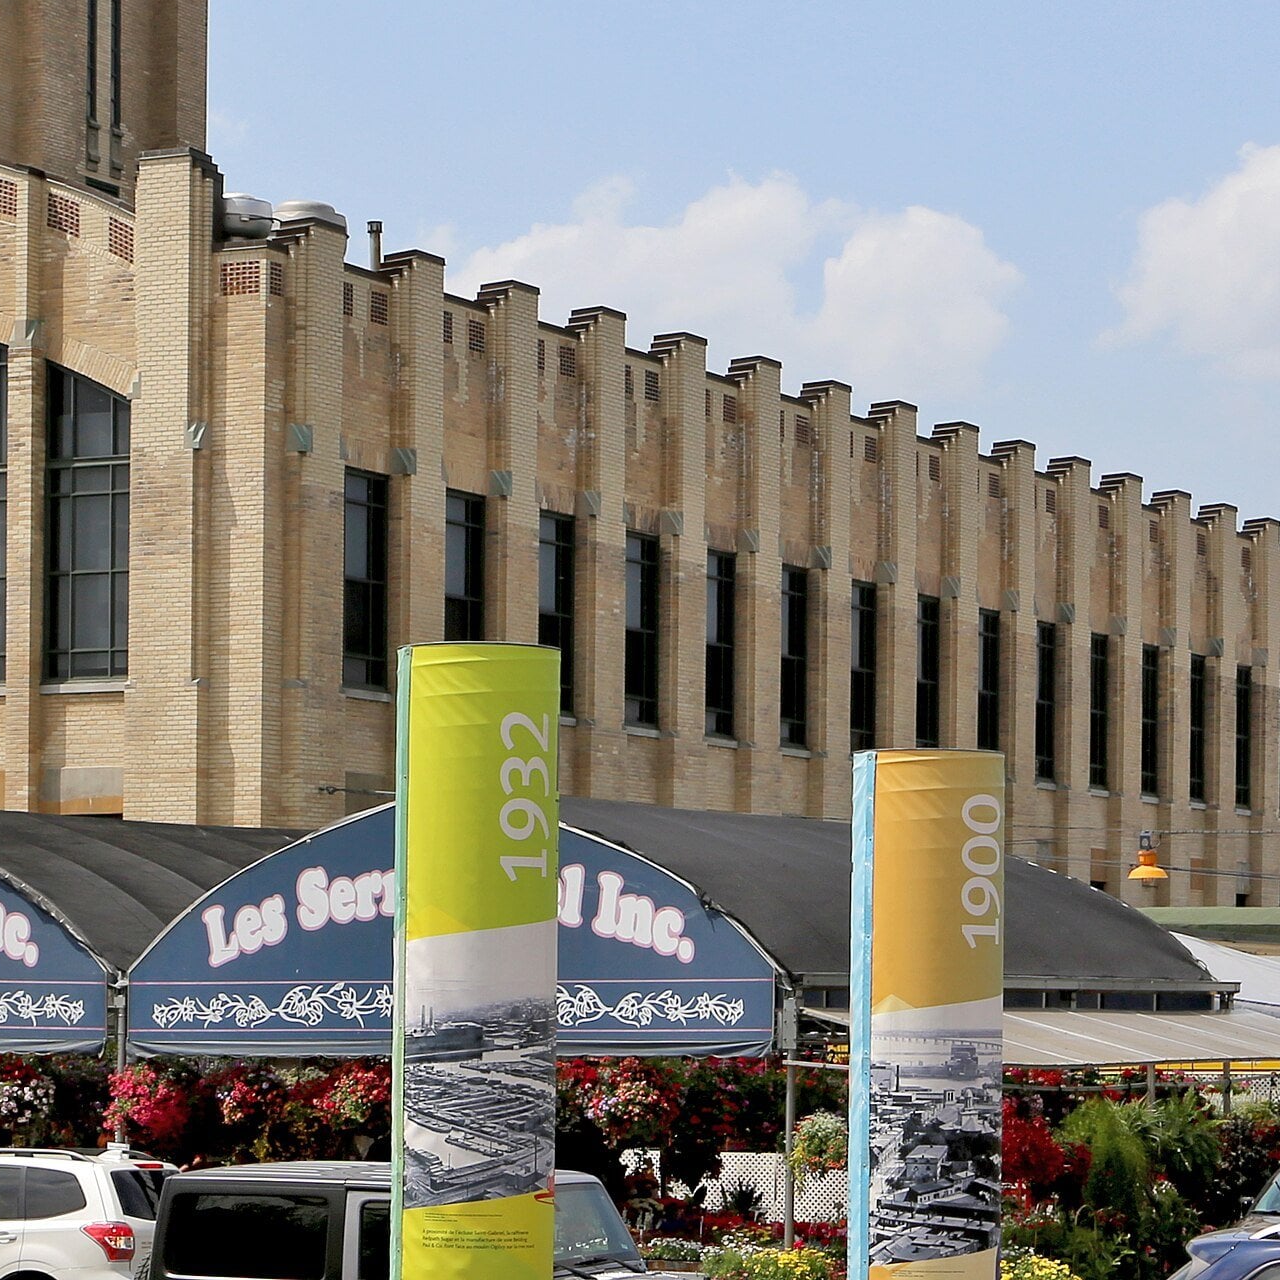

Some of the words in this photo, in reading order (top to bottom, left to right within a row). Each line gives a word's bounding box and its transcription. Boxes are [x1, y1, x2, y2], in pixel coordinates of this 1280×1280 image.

[499, 711, 551, 882] 1932
[201, 894, 288, 968] Les
[296, 866, 395, 932] Serr
[591, 870, 696, 964] Inc.
[961, 793, 1001, 949] 1900
